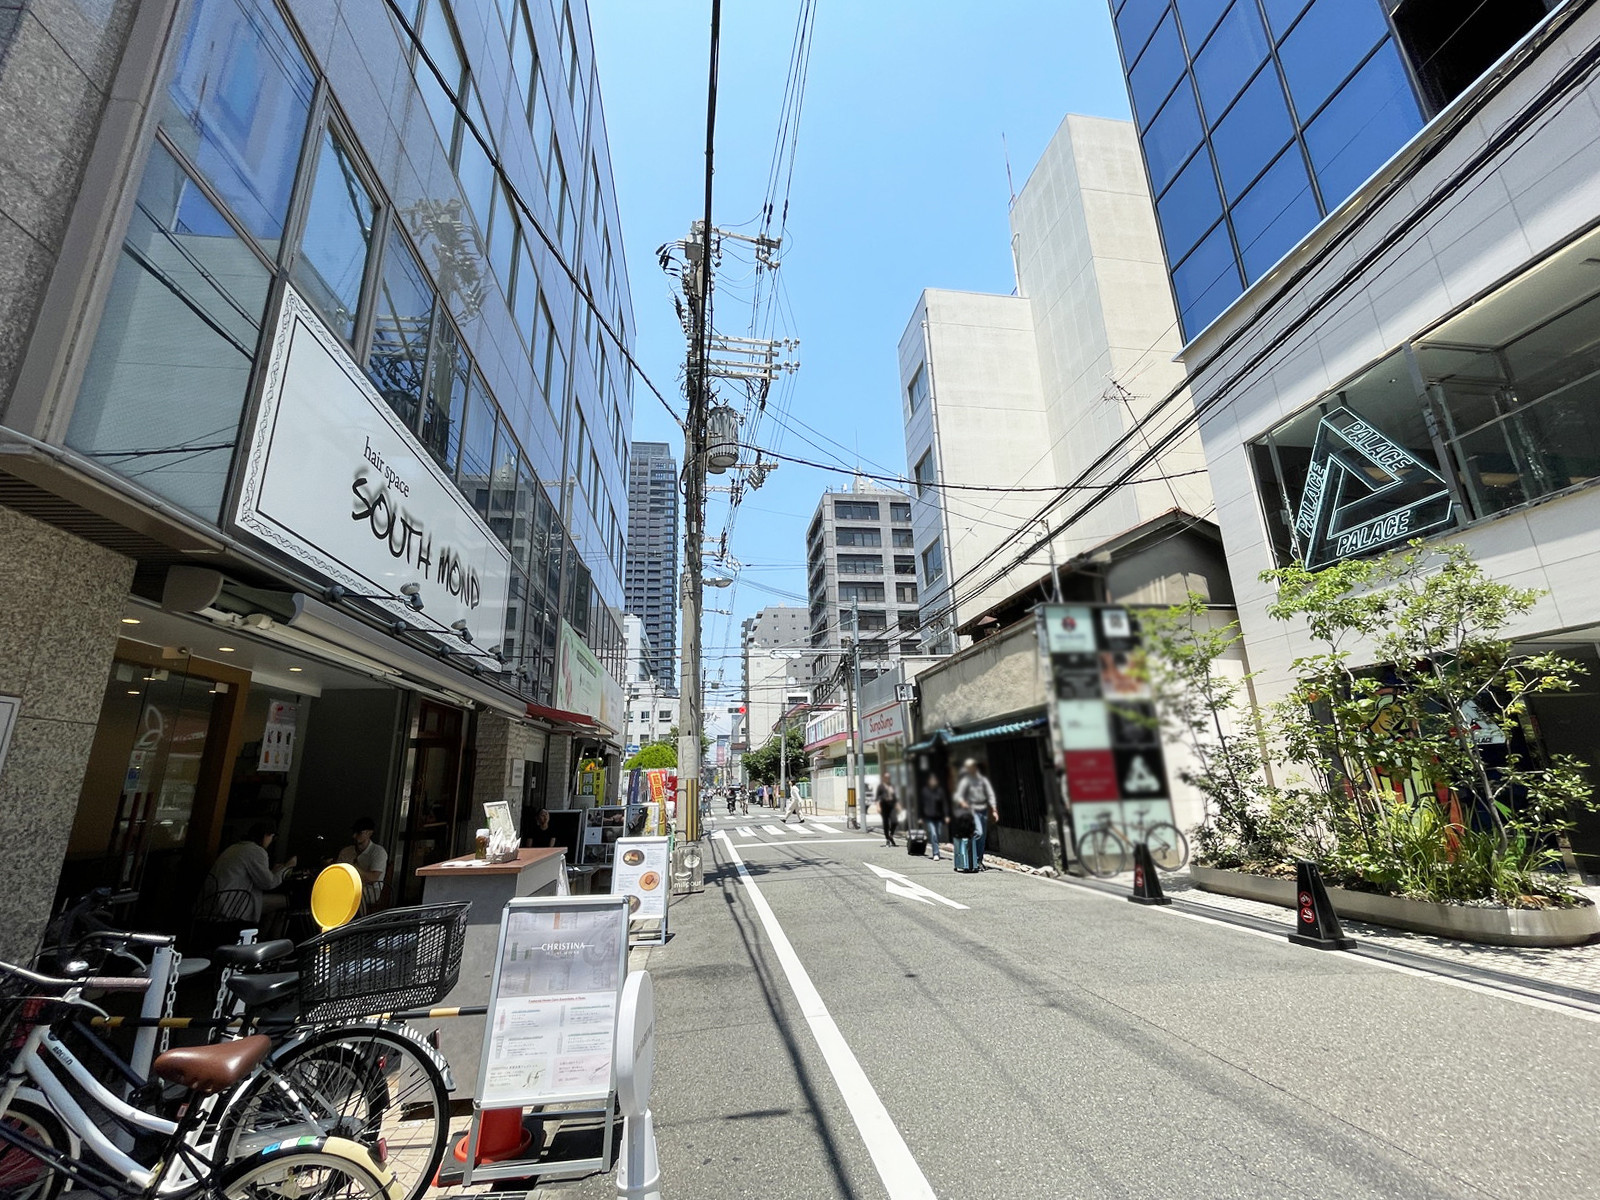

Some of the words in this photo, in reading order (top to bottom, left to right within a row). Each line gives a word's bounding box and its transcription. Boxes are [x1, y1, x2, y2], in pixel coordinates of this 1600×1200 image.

[364, 436, 385, 473] hair
[385, 465, 410, 498] space
[1342, 421, 1413, 473] PALACE
[1297, 461, 1327, 538] PALACE
[352, 477, 432, 580] SOUTH
[437, 552, 480, 610] MOND
[1336, 510, 1411, 557] PALACE
[541, 942, 586, 951] CHRISTINA
